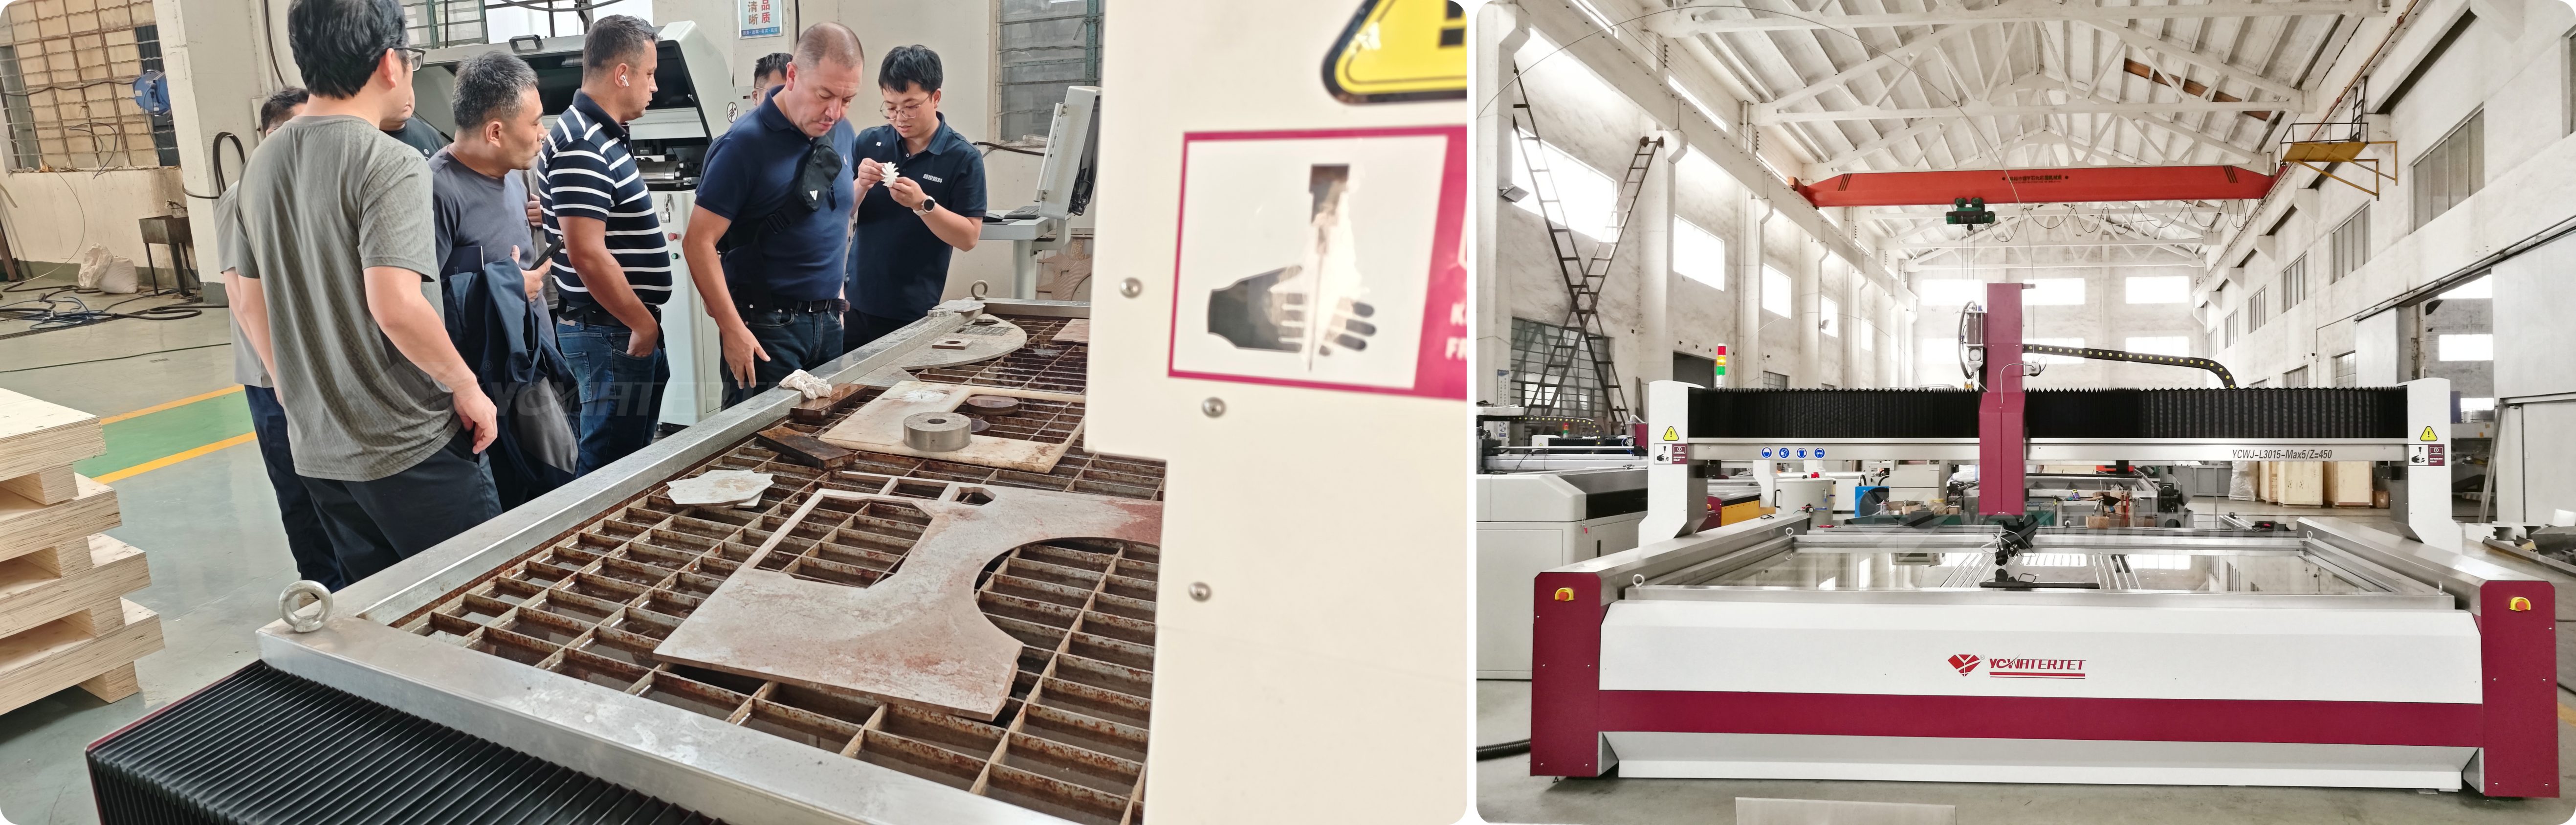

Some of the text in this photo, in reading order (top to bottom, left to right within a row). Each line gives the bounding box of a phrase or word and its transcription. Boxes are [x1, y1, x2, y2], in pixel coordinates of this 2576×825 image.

[748, 1, 758, 25] 清晰
[761, 0, 771, 23] 品质
[2232, 449, 2332, 460] YCWJ-L3015-Max5/Z=450
[1989, 654, 2087, 670] YCWATERJET
